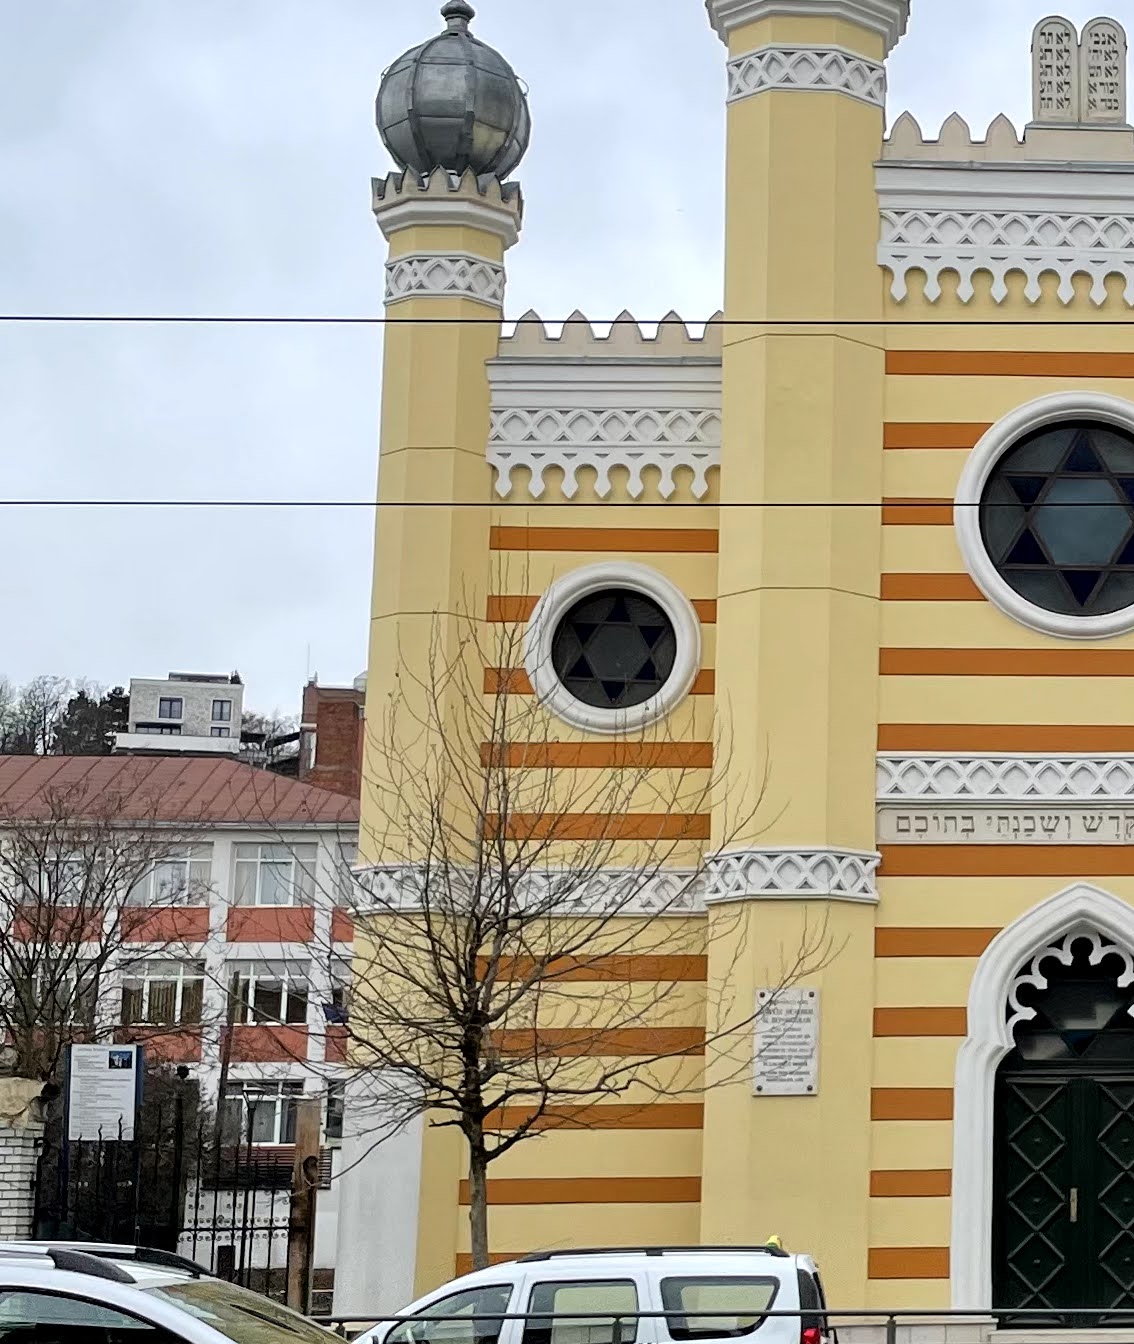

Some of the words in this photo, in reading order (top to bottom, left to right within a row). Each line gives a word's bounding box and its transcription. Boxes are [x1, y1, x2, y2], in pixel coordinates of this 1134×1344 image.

[1056, 46, 1070, 61] לא
[1104, 46, 1119, 61] לא
[1056, 62, 1070, 77] לא
[1105, 62, 1118, 78] לא
[1057, 79, 1070, 93] לא
[1056, 93, 1070, 109] לא
